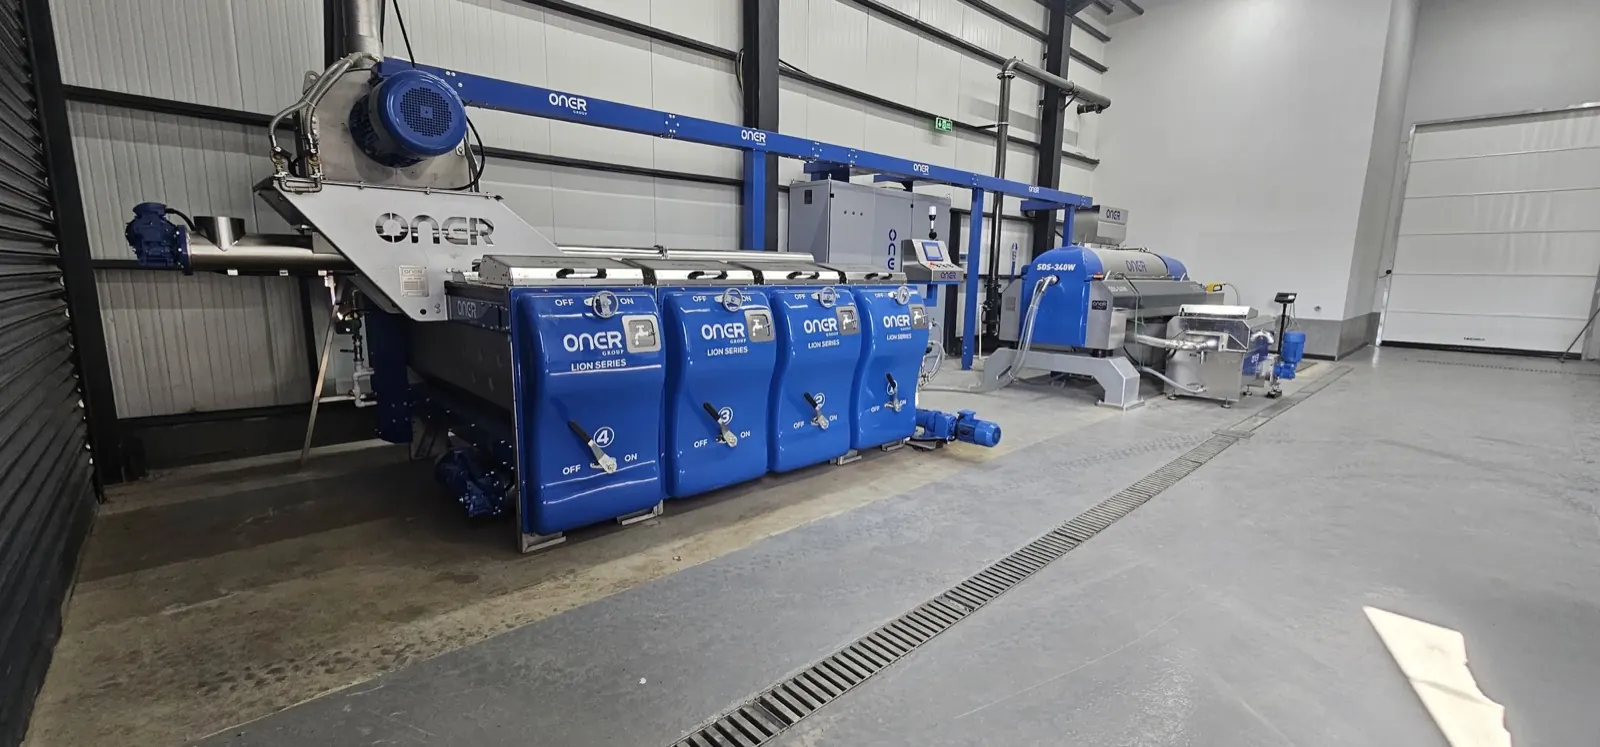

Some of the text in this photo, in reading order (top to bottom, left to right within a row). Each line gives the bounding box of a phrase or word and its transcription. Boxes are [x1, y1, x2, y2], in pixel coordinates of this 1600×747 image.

[548, 92, 587, 111] ONER
[741, 129, 766, 143] ONER
[913, 163, 929, 173] ONER
[375, 212, 495, 246] ONER
[1036, 263, 1077, 271] SDS-340W
[554, 297, 634, 307] OFF ON
[803, 317, 838, 334] ONER
[883, 315, 910, 328] ONER
[701, 322, 746, 340] ONER
[563, 331, 623, 352] ONER
[808, 339, 840, 349] LION SERIES
[602, 349, 624, 357] GROUP
[707, 346, 748, 357] LION SERIES
[571, 358, 627, 372] LION SERIES
[720, 409, 730, 423] 3
[793, 420, 805, 429] OFF
[596, 429, 610, 445] 4
[693, 430, 751, 448] OFF ON
[562, 453, 638, 475] OFF ON
